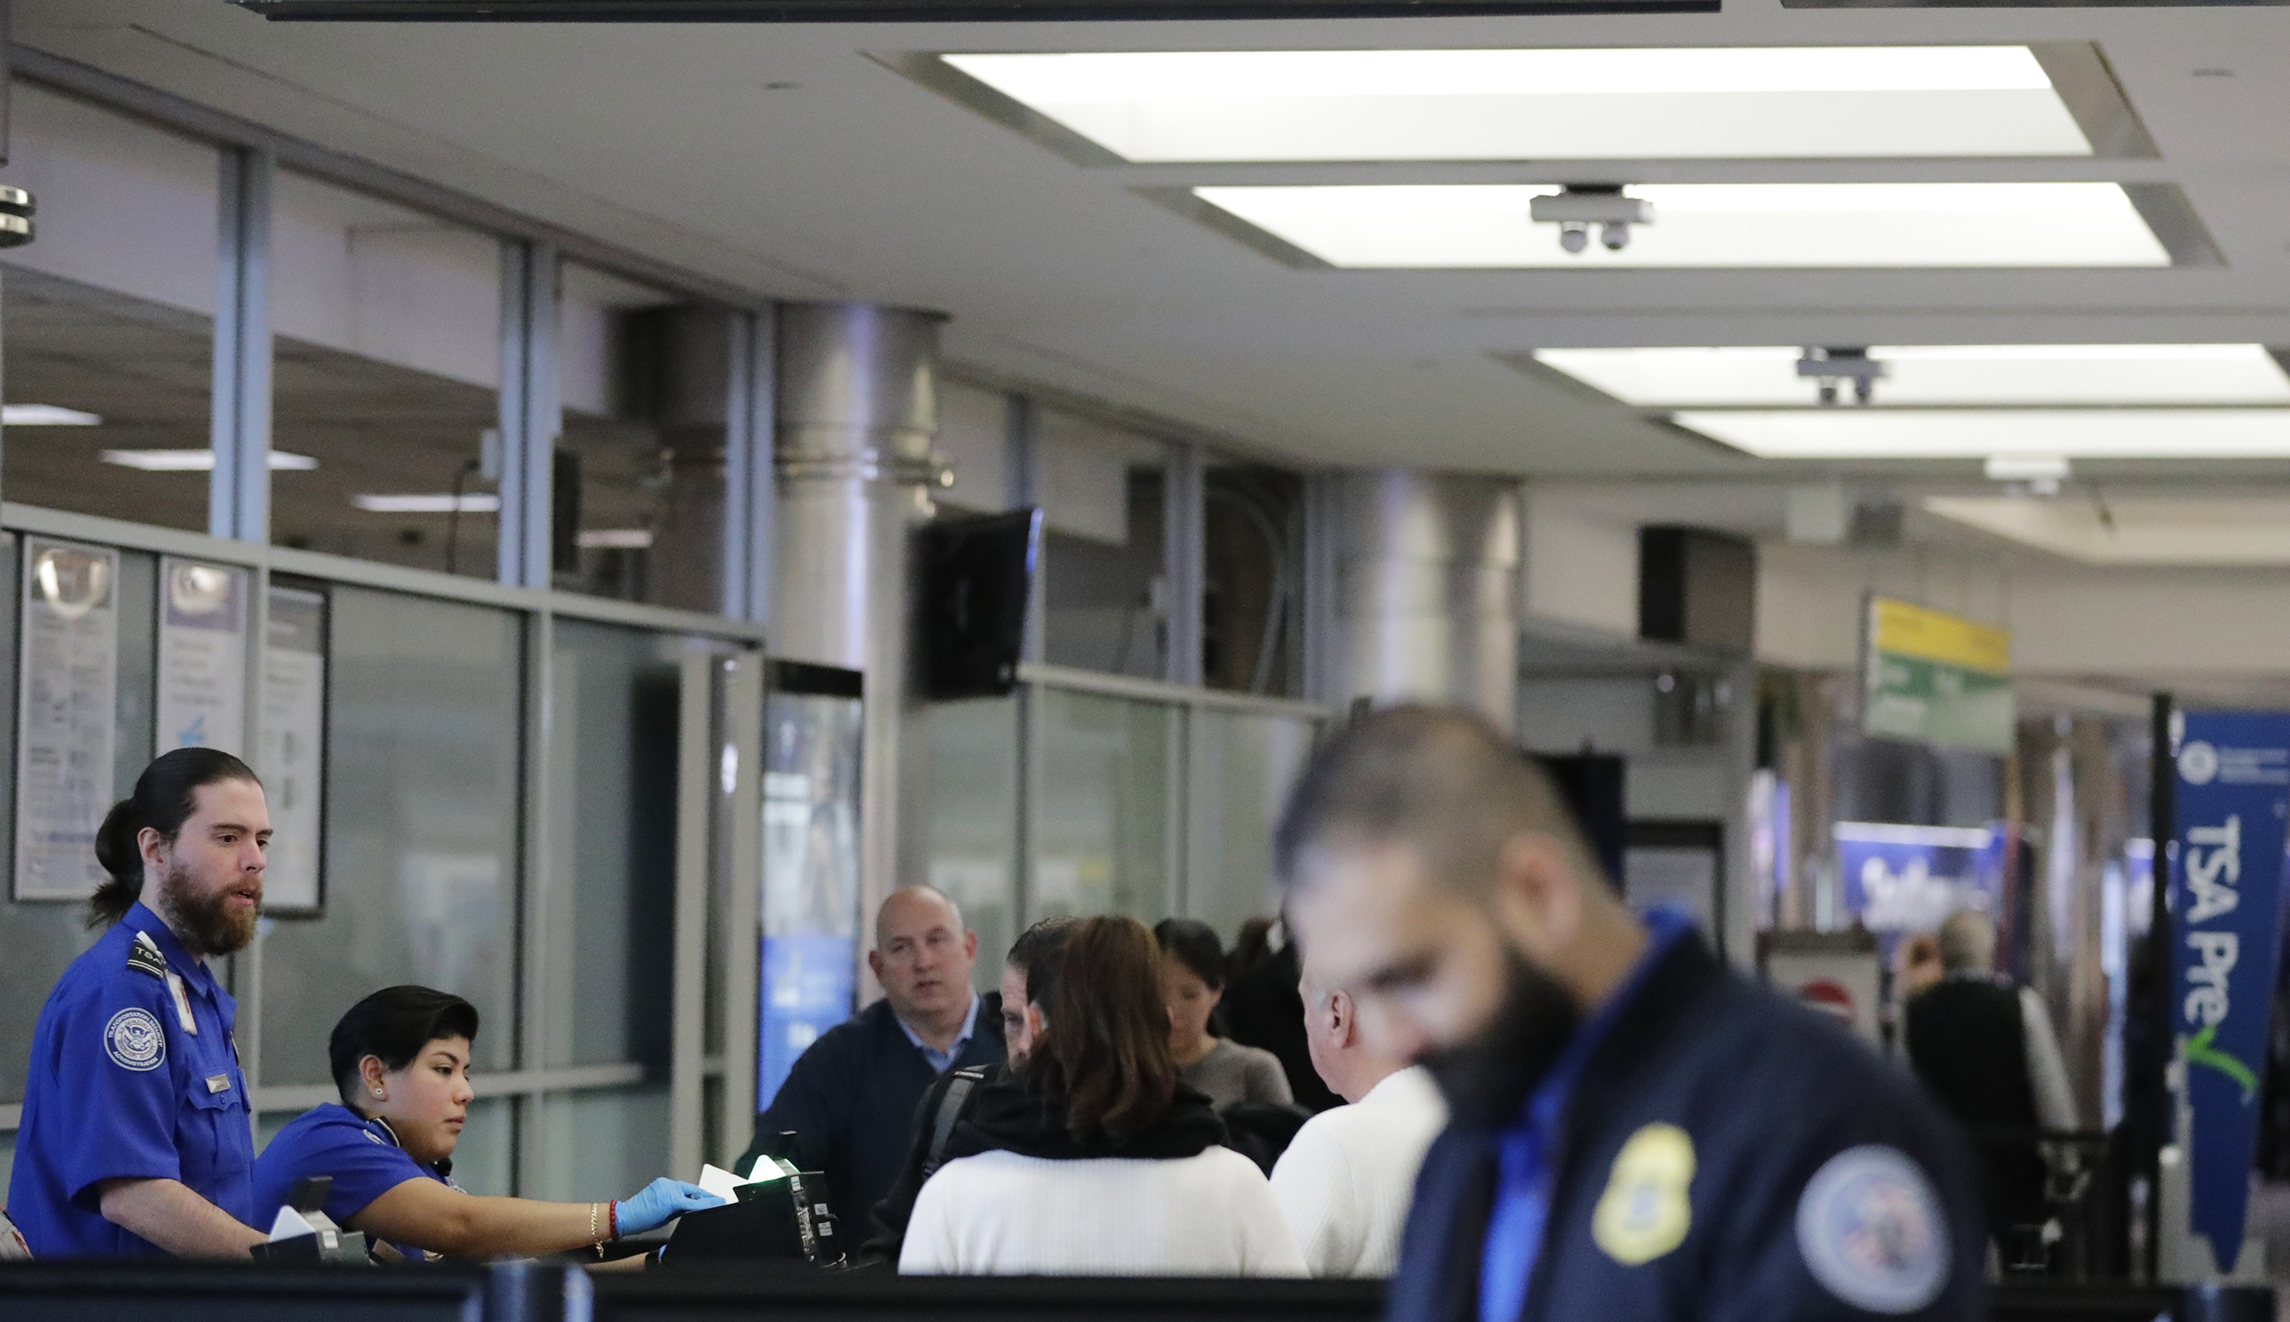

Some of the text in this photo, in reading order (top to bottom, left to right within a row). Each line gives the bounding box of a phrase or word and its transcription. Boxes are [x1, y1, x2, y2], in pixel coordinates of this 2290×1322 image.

[2184, 815, 2240, 1024] TSA Pre
[108, 1012, 150, 1038] TRANSPORTATION
